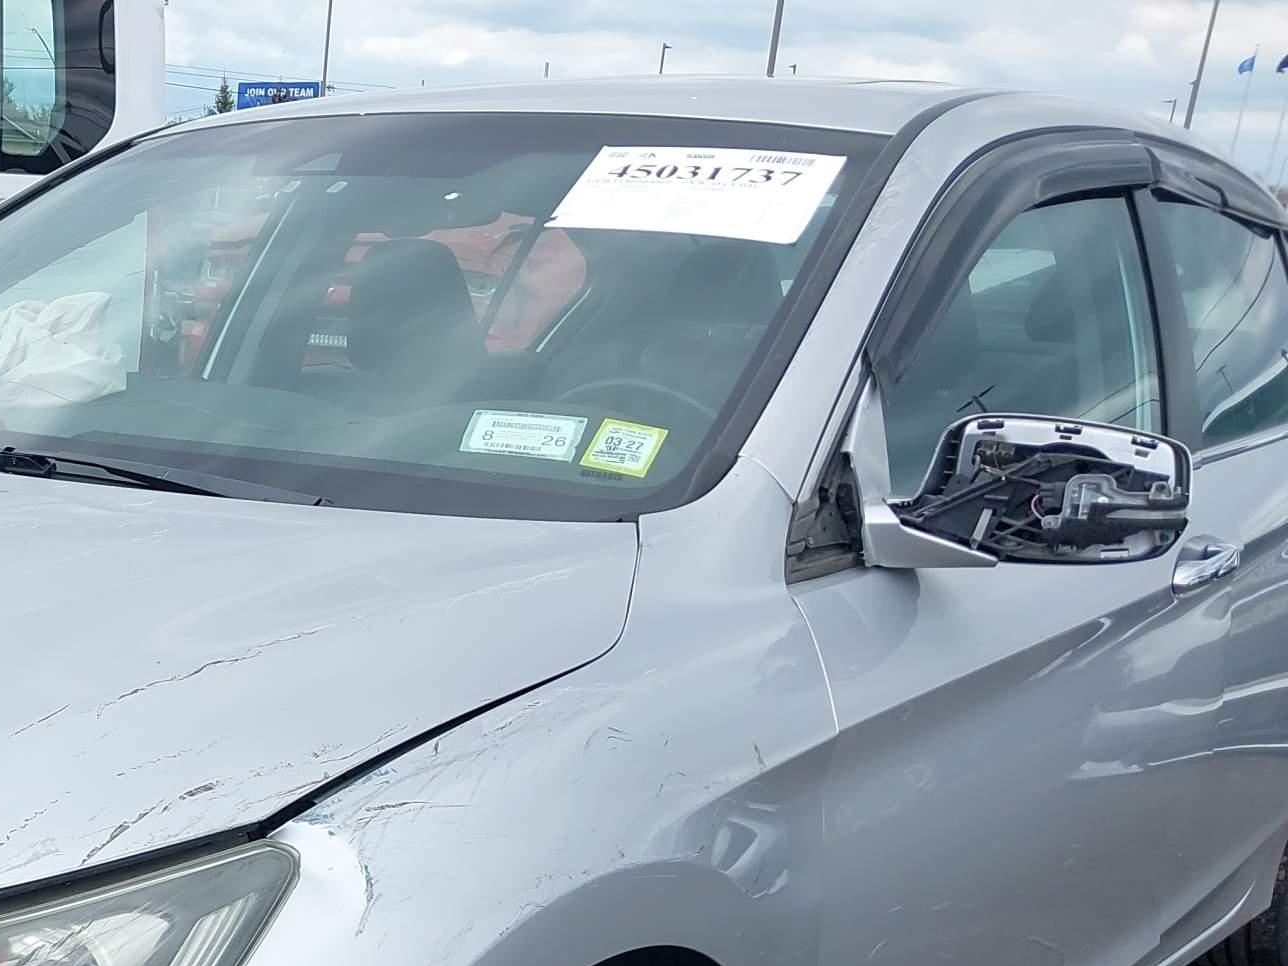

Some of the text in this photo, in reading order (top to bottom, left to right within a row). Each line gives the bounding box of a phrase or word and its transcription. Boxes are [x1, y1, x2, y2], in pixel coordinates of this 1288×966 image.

[244, 87, 314, 98] JOIN OUR TEAM
[607, 163, 804, 186] 45031737
[481, 429, 495, 441] 8
[541, 434, 568, 448] 26
